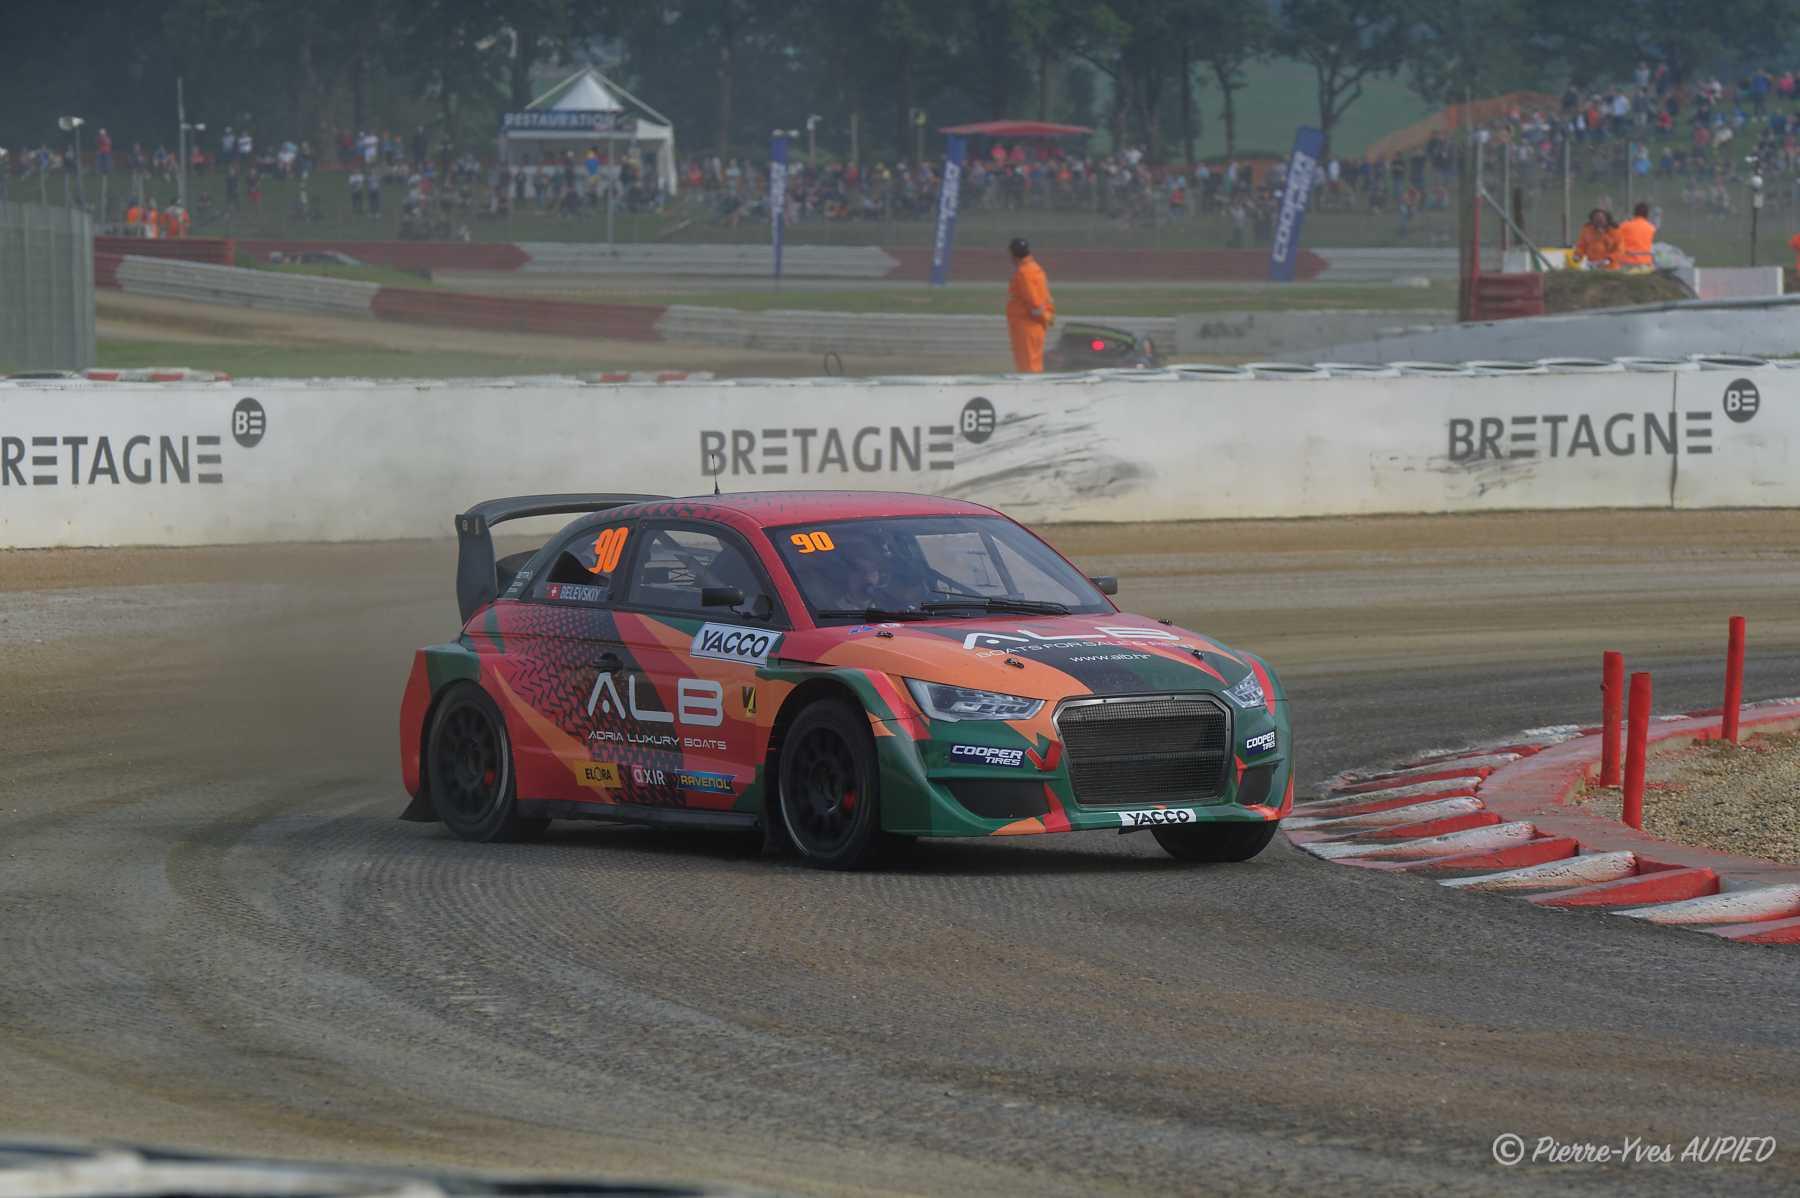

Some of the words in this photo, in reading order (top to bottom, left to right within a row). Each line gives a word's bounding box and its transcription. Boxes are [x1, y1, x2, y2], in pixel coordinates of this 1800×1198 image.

[1449, 411, 1712, 459] BRETAGNE
[700, 425, 955, 477] BRETAGNE
[588, 526, 629, 574] 90
[790, 531, 836, 554] 90
[701, 629, 770, 658] YACCO
[963, 626, 1180, 650] ALB
[587, 671, 724, 727] ALB
[588, 730, 625, 742] ADRIA
[627, 733, 680, 746] LUXURY
[684, 737, 728, 750] BOATS
[1246, 731, 1275, 749] COOPER
[951, 745, 1024, 760] COOPER
[984, 756, 1021, 766] TIRES
[1127, 809, 1190, 826] YACCO
